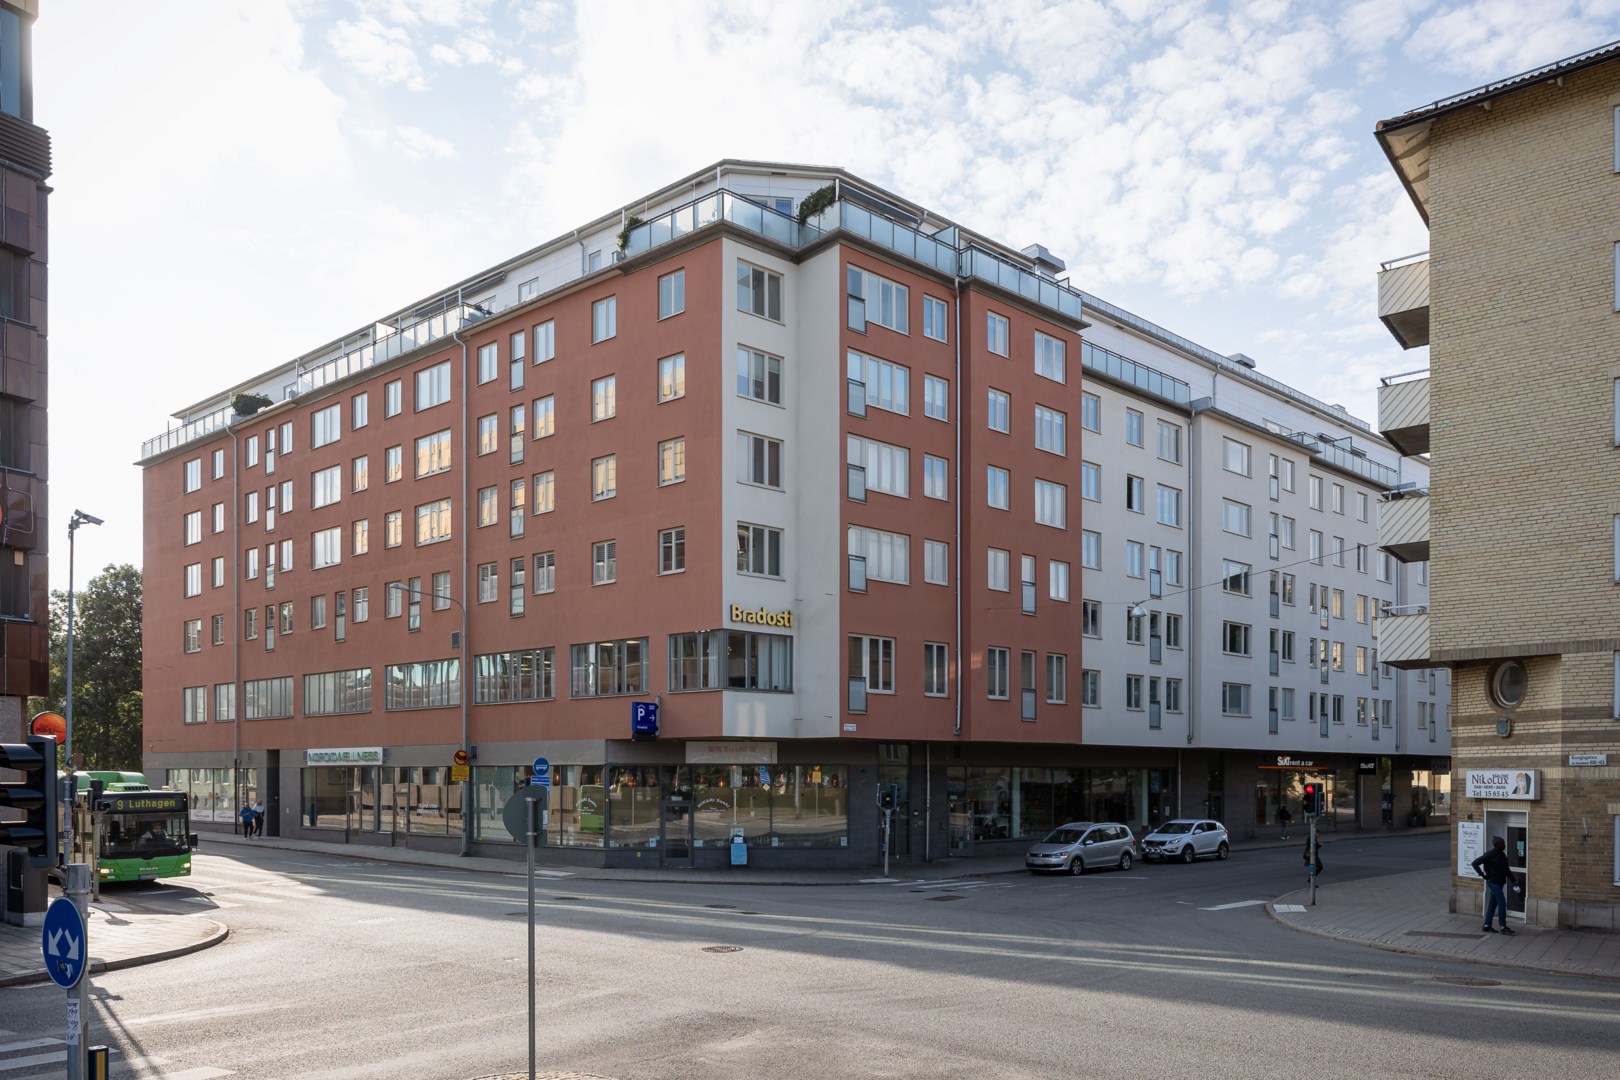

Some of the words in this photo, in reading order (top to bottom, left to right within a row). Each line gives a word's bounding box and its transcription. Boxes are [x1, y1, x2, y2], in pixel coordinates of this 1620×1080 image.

[730, 603, 794, 627] Bradosti
[637, 708, 645, 721] P
[117, 801, 124, 810] 9
[129, 800, 176, 809] Luthagen
